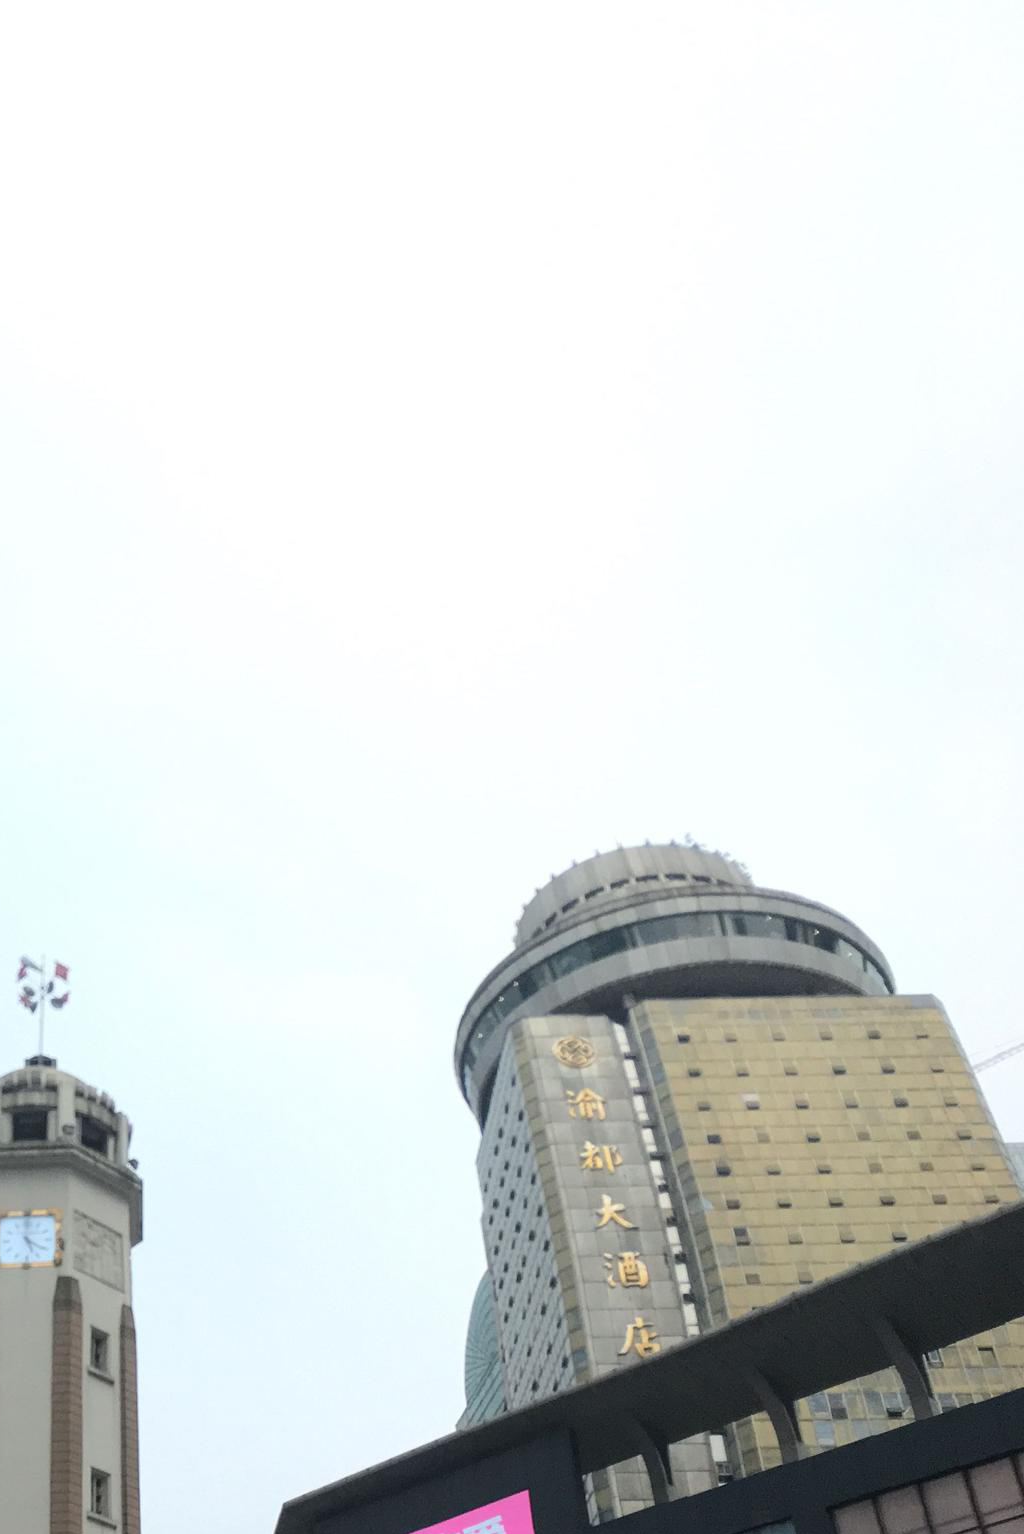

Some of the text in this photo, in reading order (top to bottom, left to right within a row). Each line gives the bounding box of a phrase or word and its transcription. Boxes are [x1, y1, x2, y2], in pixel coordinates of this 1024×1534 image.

[566, 1087, 662, 1358] 渝都大酒店
